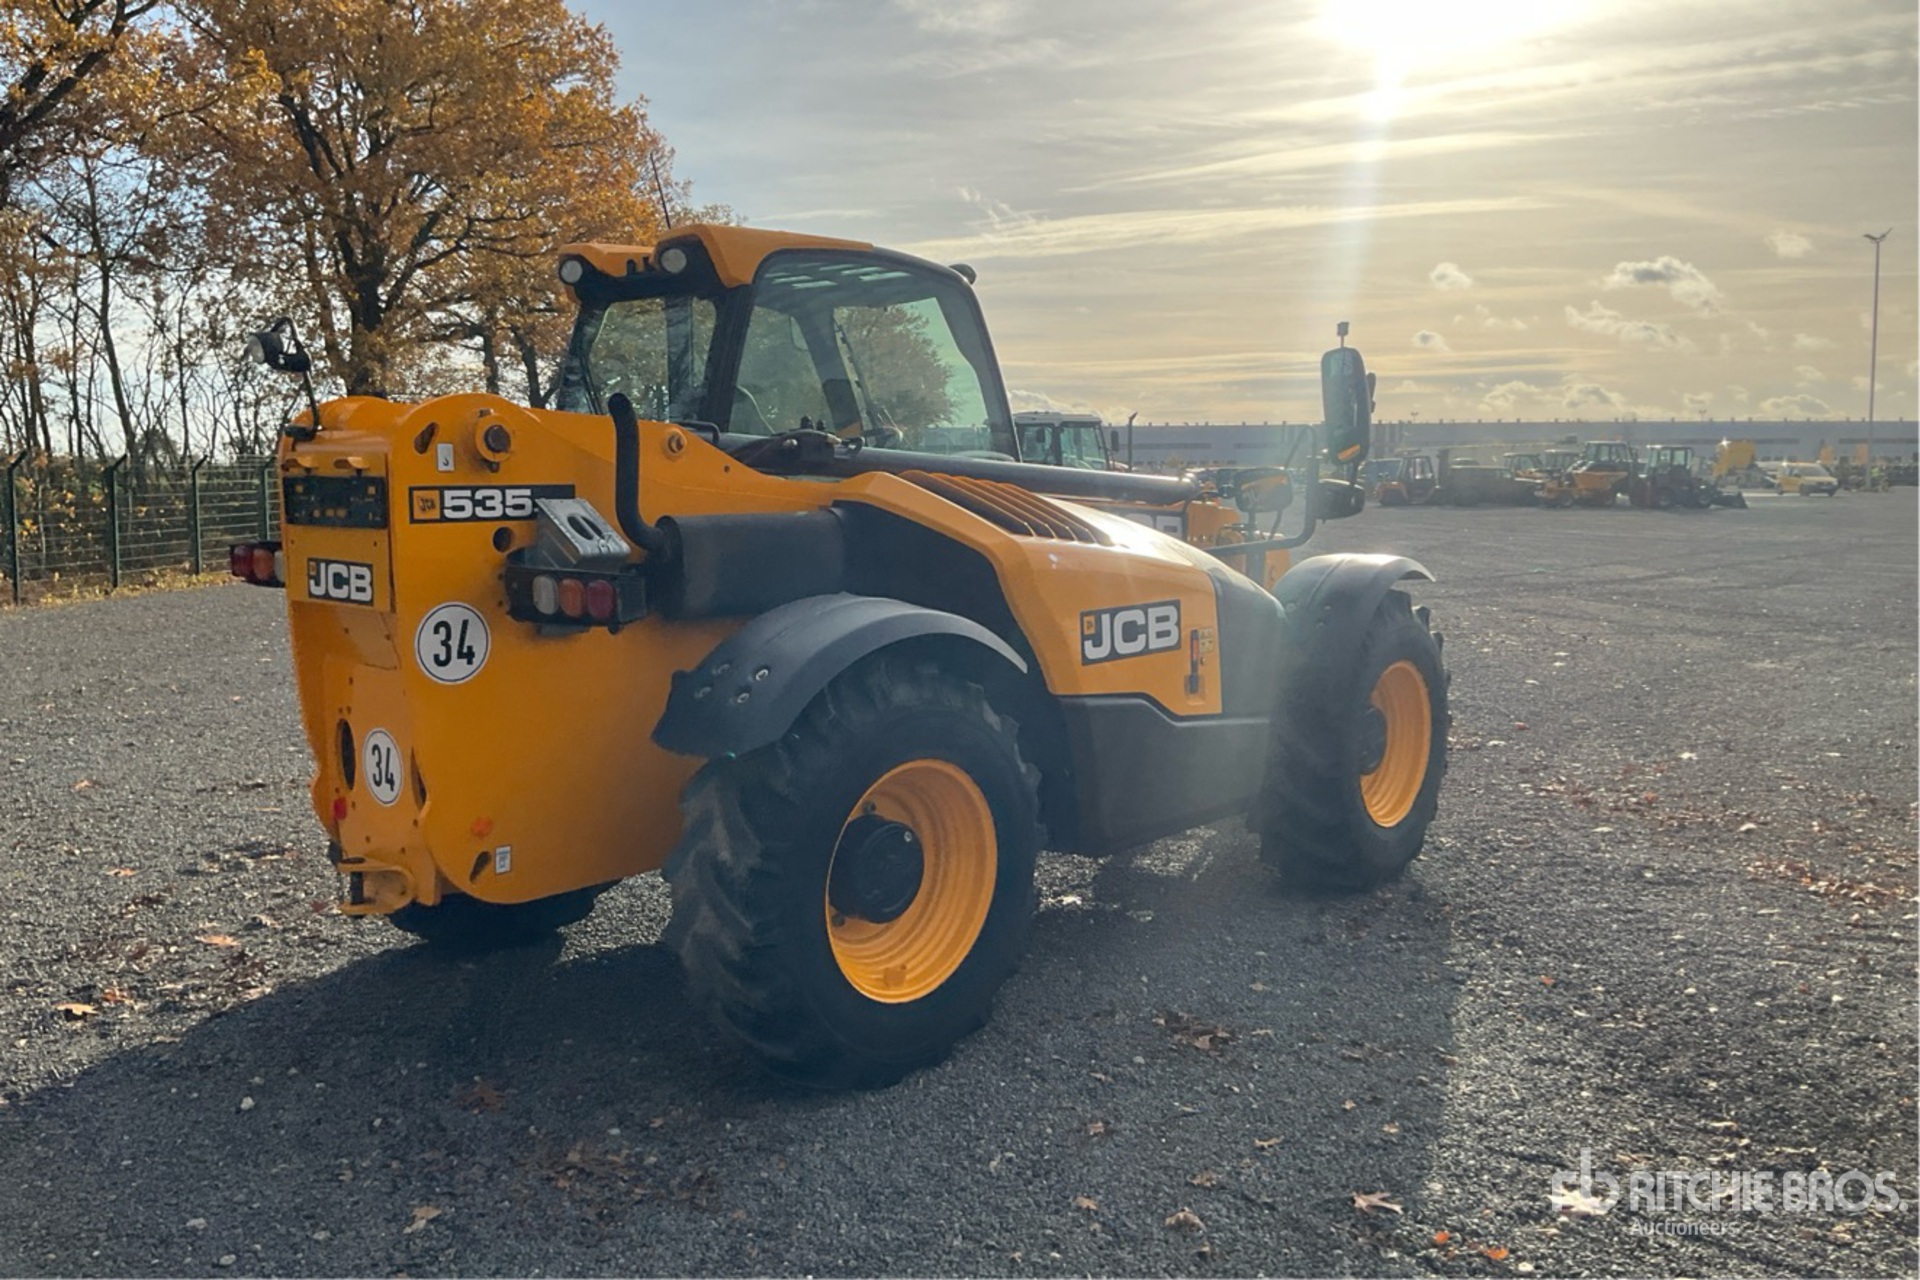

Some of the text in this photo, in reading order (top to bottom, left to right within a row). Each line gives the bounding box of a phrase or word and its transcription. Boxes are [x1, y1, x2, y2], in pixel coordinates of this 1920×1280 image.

[309, 562, 373, 602] JCB
[433, 619, 475, 668] 34
[1084, 605, 1179, 660] JCB
[372, 743, 395, 792] 34
